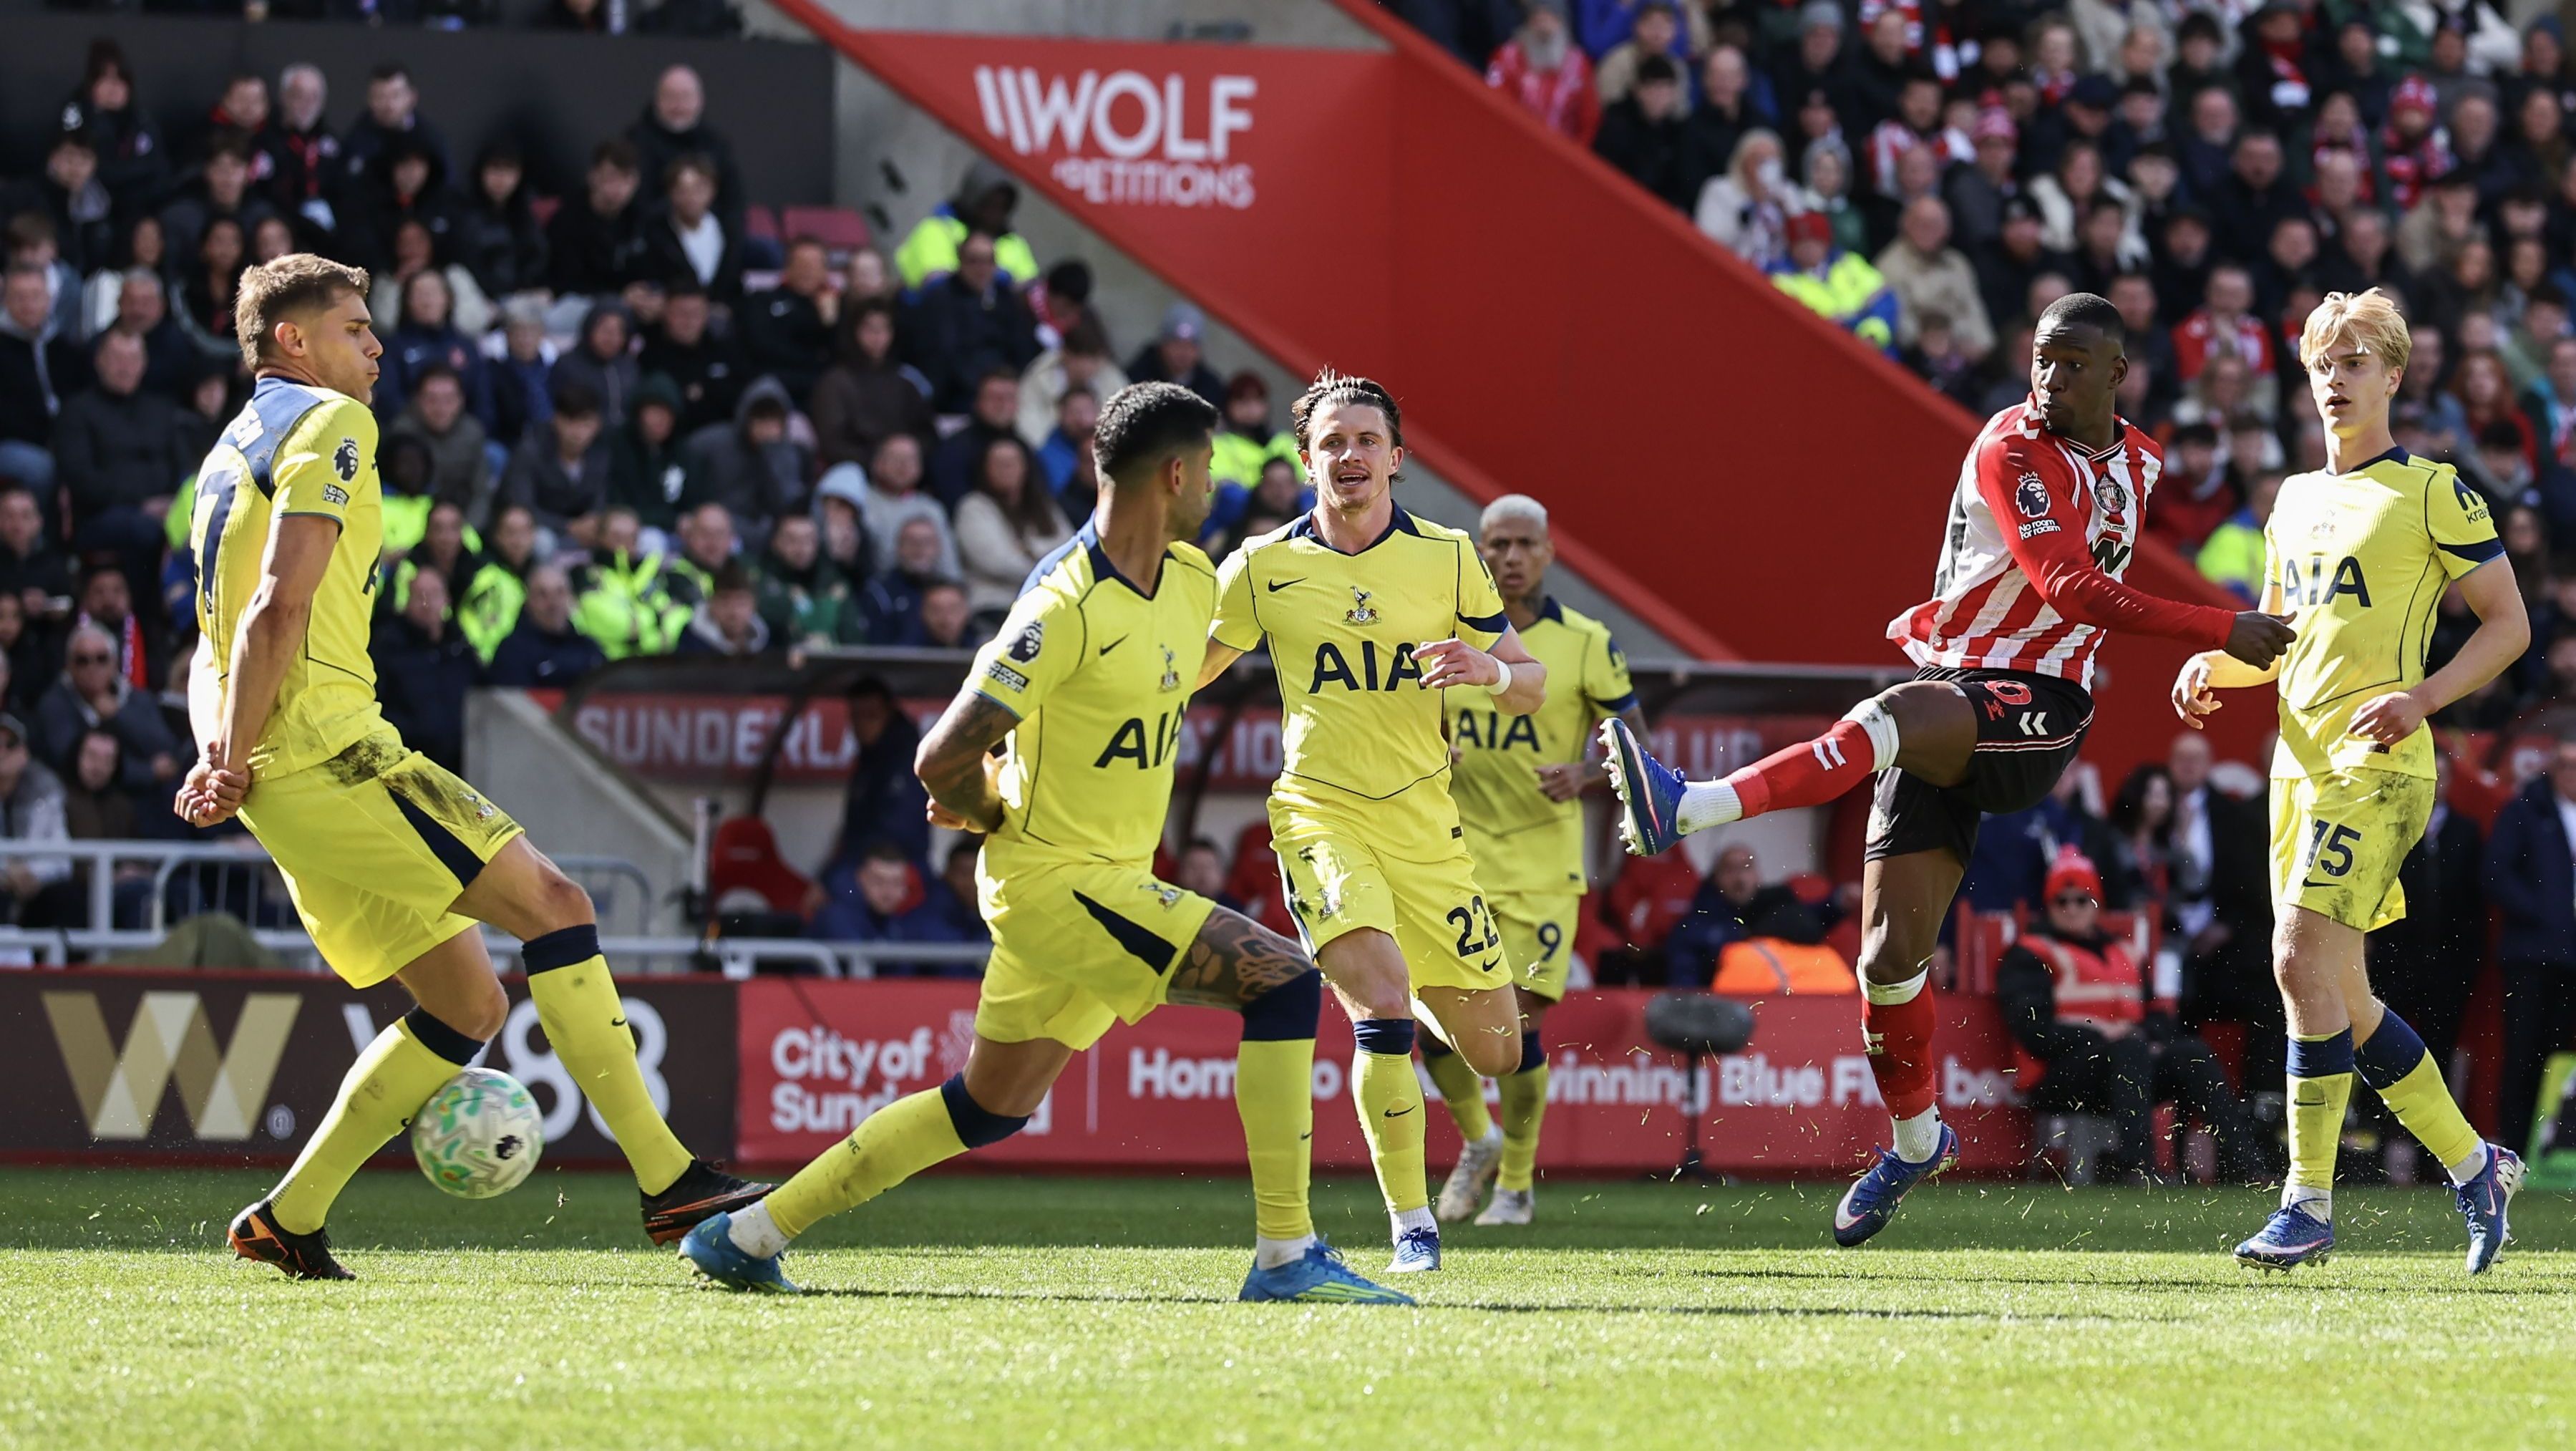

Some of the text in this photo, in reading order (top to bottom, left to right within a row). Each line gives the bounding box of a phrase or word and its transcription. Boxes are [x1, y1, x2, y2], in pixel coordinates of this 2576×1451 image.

[1019, 67, 1257, 161] WOLF
[2018, 519, 2056, 533] No room
[2021, 525, 2061, 540] for racism
[2284, 555, 2372, 608] AIA
[1308, 641, 1426, 694] AIA
[1456, 707, 1542, 752] AIA
[2305, 819, 2361, 877] 15
[1447, 895, 1499, 958] 22
[1537, 922, 1562, 962] 9
[771, 1026, 933, 1090] City of
[1128, 1047, 1237, 1099] Hom
[1719, 1053, 1824, 1105] Blue
